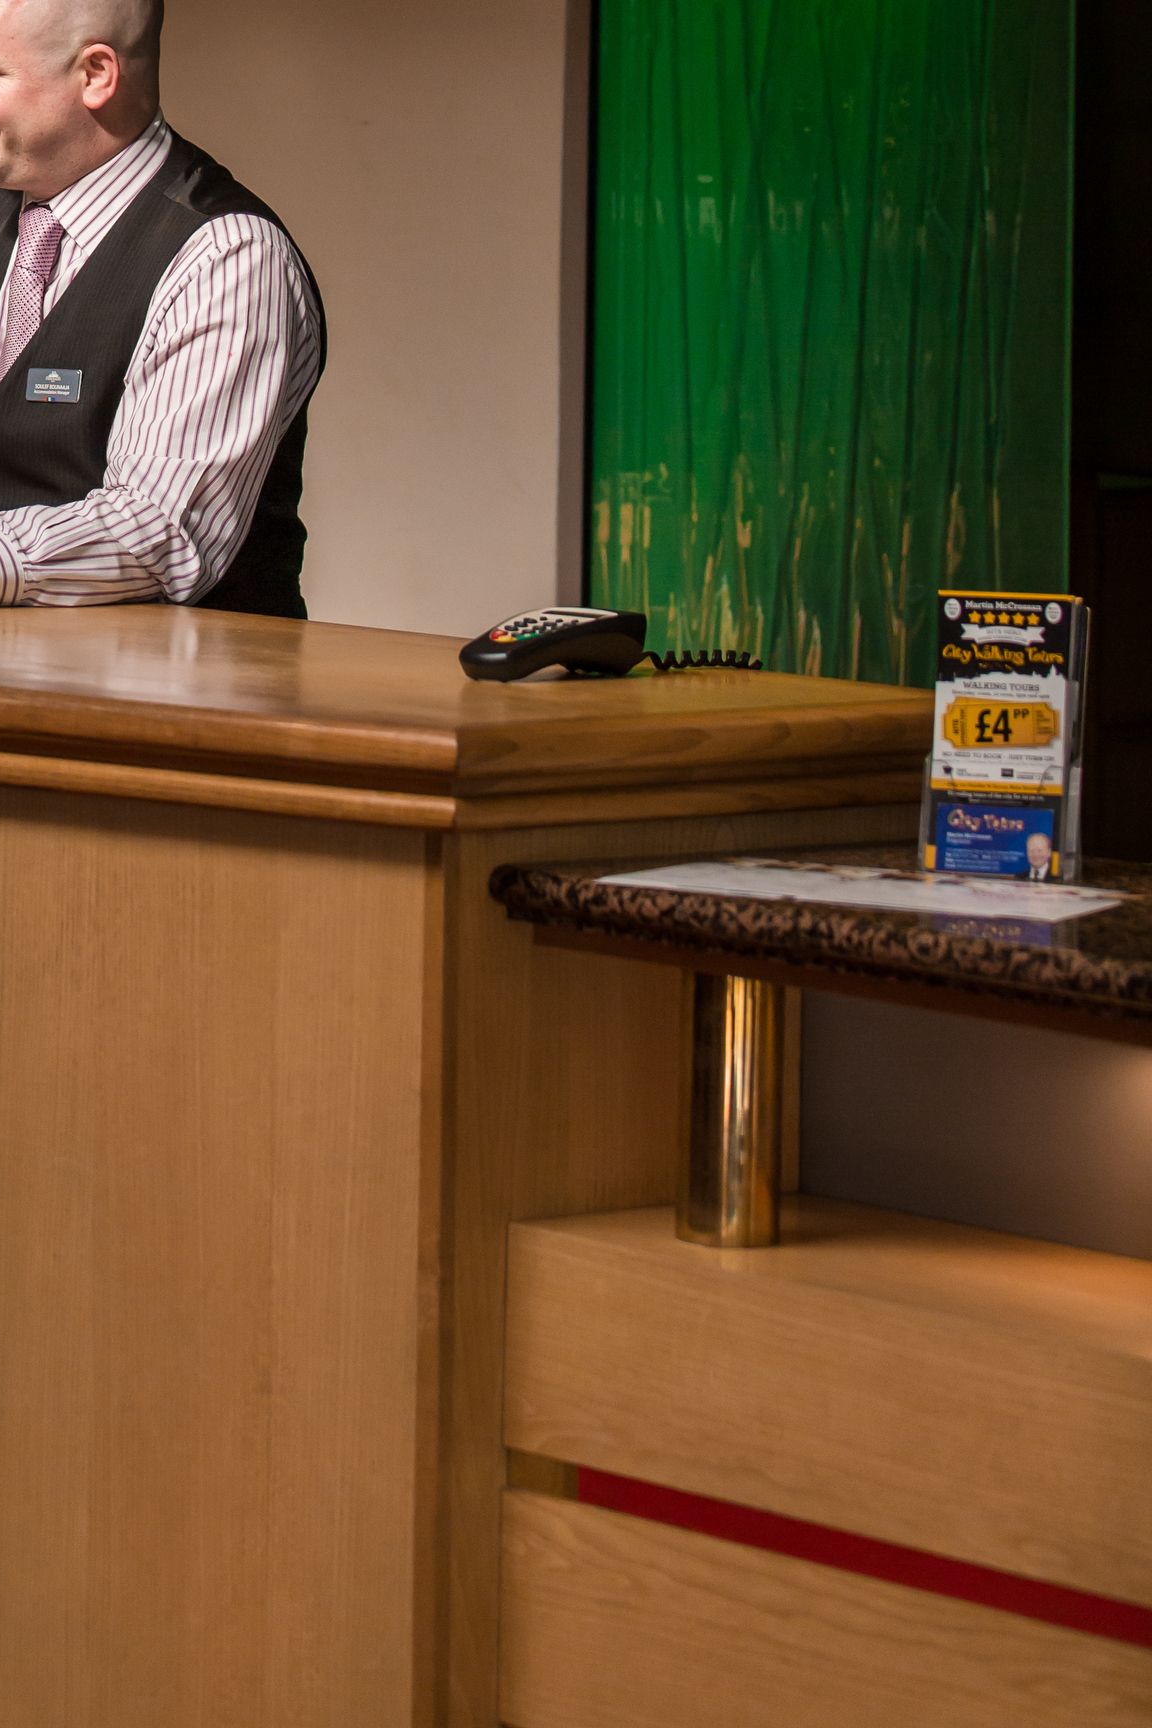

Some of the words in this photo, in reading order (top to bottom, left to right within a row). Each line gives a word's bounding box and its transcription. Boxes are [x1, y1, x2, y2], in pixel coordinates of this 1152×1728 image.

[965, 600, 994, 609] Martin
[995, 601, 1042, 612] McCrossan
[942, 643, 972, 664] City
[1025, 646, 1064, 665] Tours
[963, 681, 1007, 691] WALKING
[1010, 682, 1040, 691] TOURS
[975, 708, 1012, 743] £4
